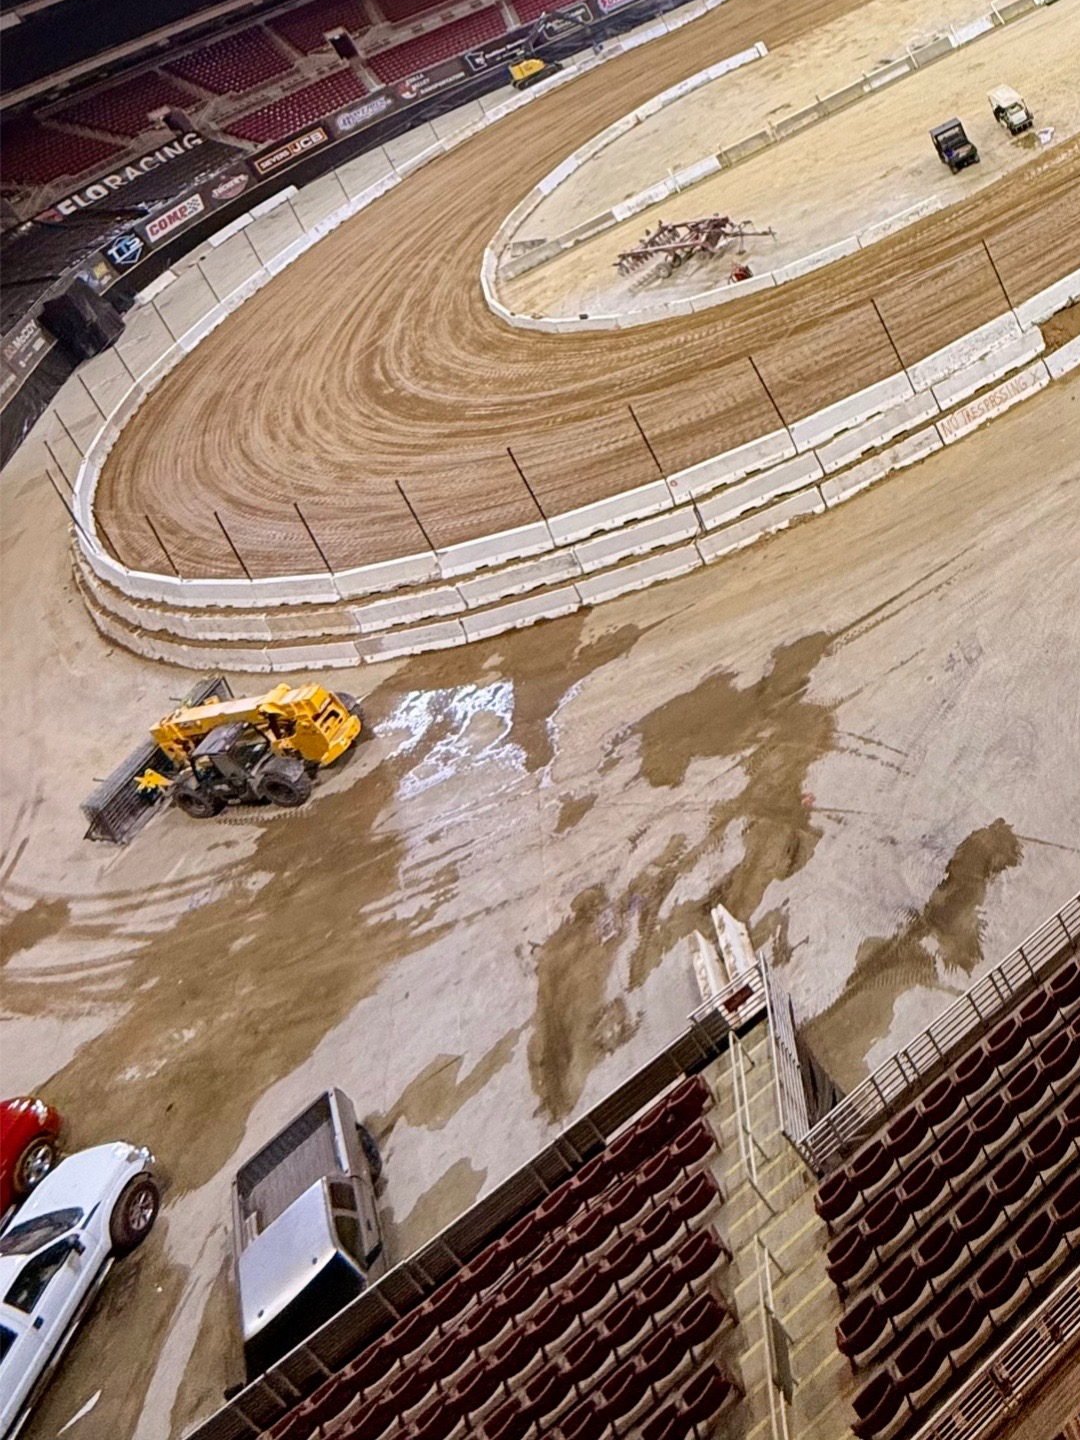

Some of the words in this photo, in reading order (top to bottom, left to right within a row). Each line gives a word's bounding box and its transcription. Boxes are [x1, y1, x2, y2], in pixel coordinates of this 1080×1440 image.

[260, 150, 290, 169] SEVERS
[292, 131, 324, 153] JCB
[57, 132, 203, 216] FLORACING
[150, 205, 188, 237] COMP
[940, 414, 960, 438] NO
